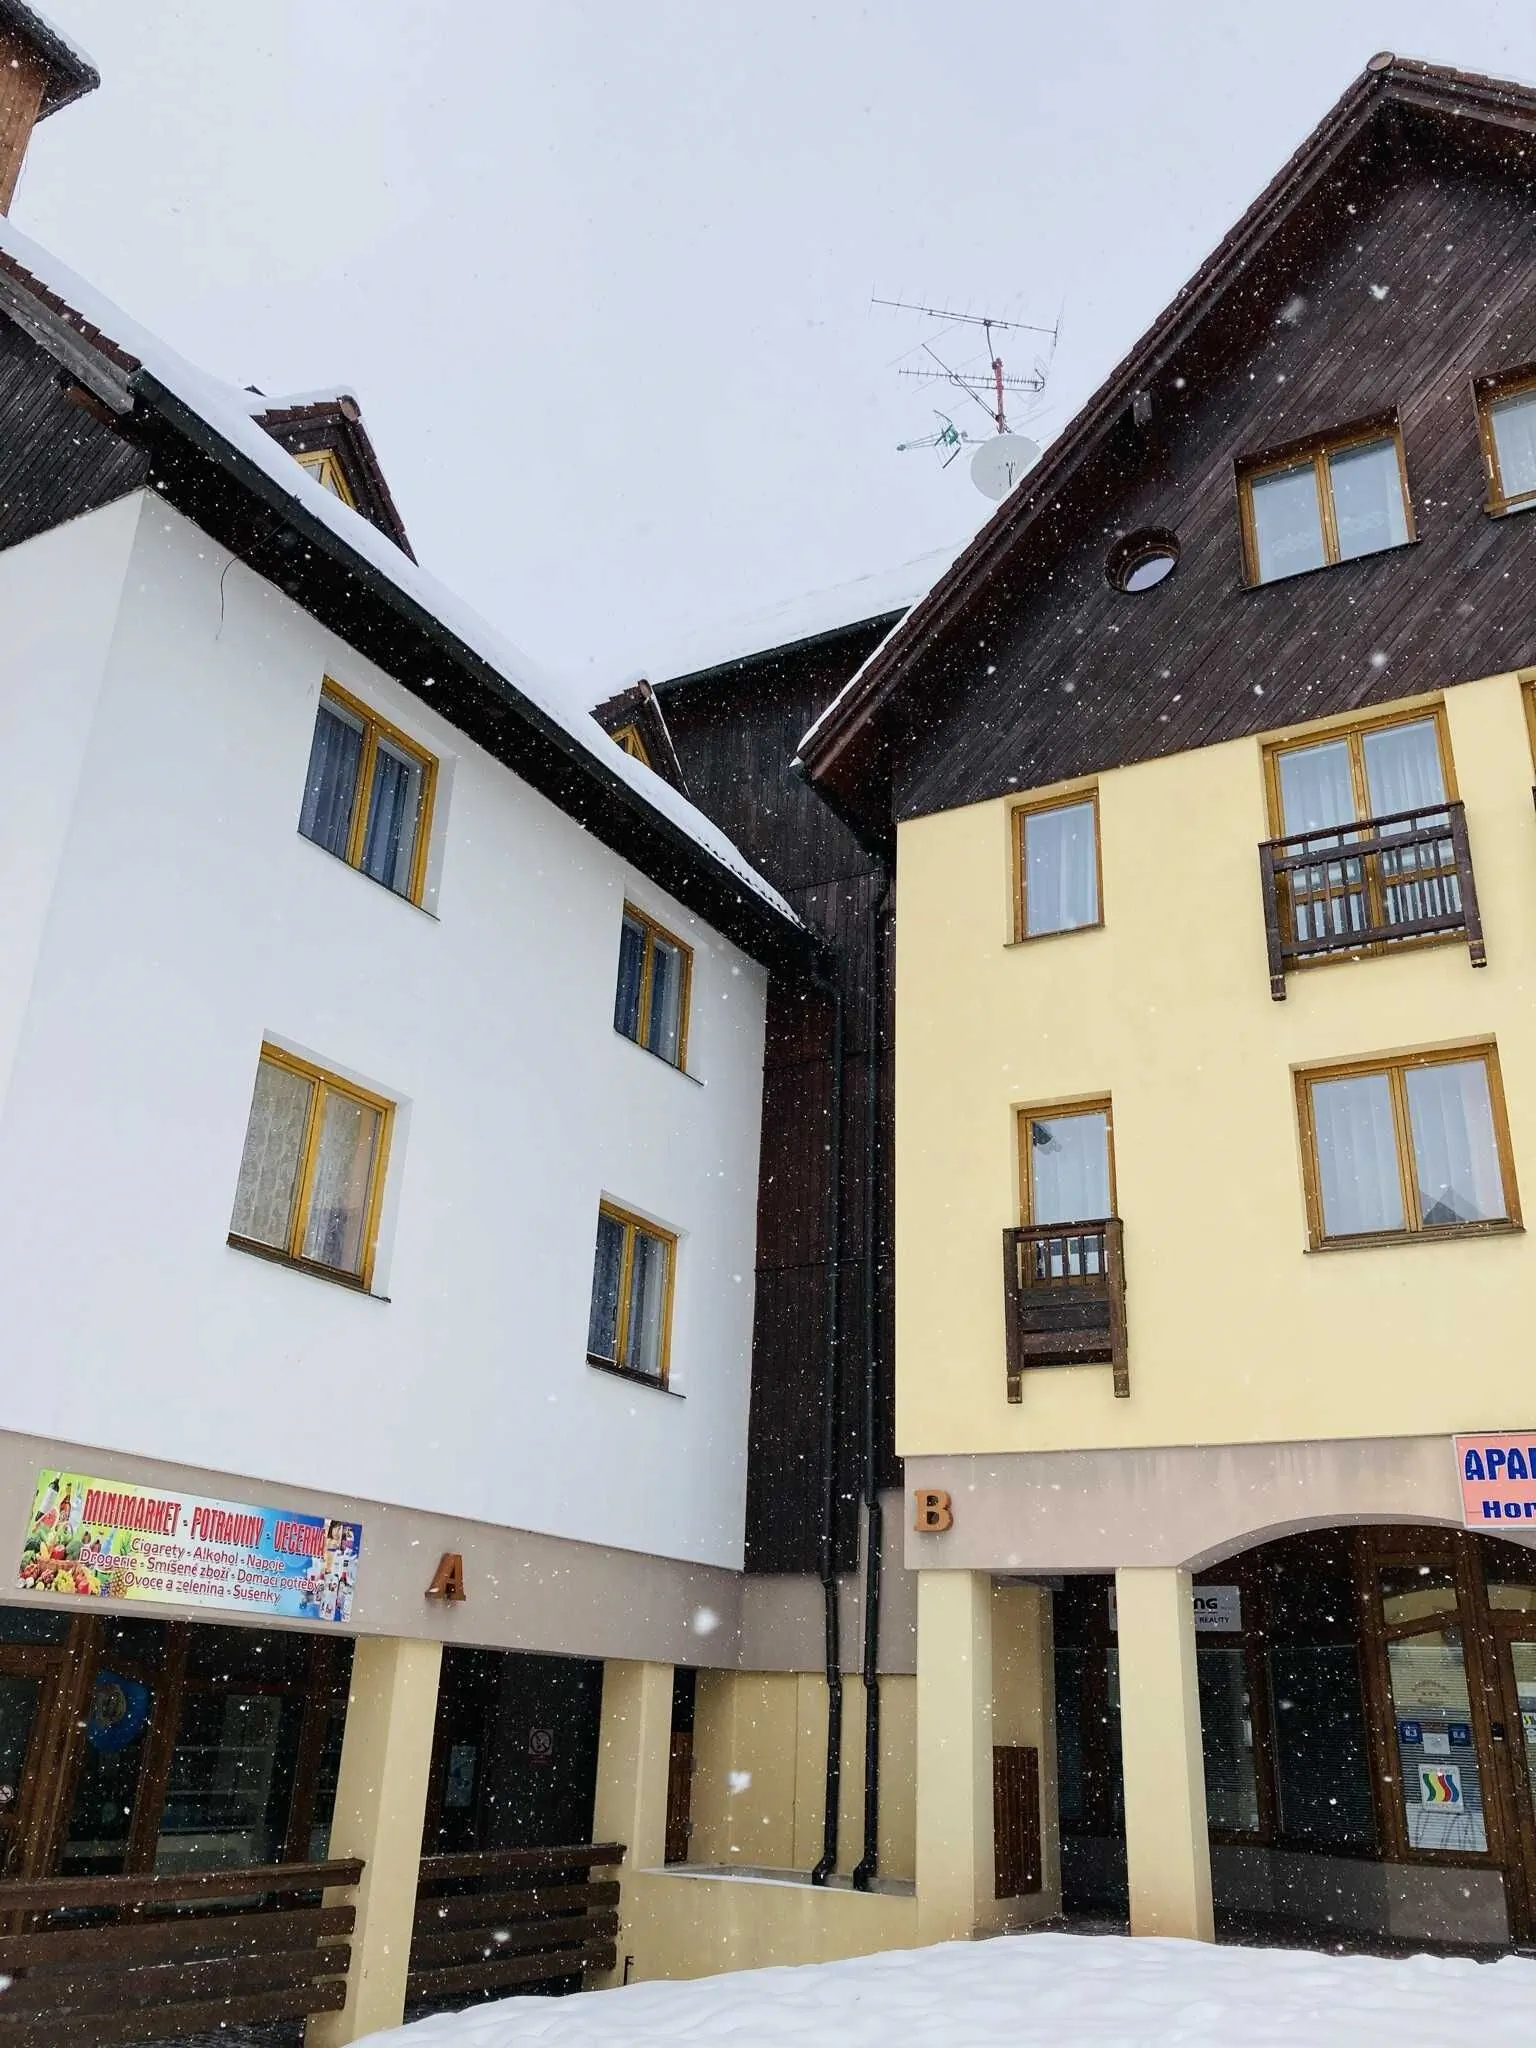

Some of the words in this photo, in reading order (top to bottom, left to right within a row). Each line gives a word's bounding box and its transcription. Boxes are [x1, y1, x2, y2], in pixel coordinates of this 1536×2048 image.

[83, 1489, 181, 1536] MINIMARKET
[190, 1506, 264, 1549] POTRAVINY
[914, 1489, 953, 1532] B
[80, 1548, 138, 1571] Drogerie
[200, 1564, 230, 1579] zboží
[131, 1537, 185, 1559] Cigarety
[193, 1546, 238, 1564] Alkohol
[124, 1571, 163, 1588] Ovoce
[166, 1580, 173, 1590] a
[176, 1579, 224, 1595] zelenina
[425, 1552, 466, 1601] A
